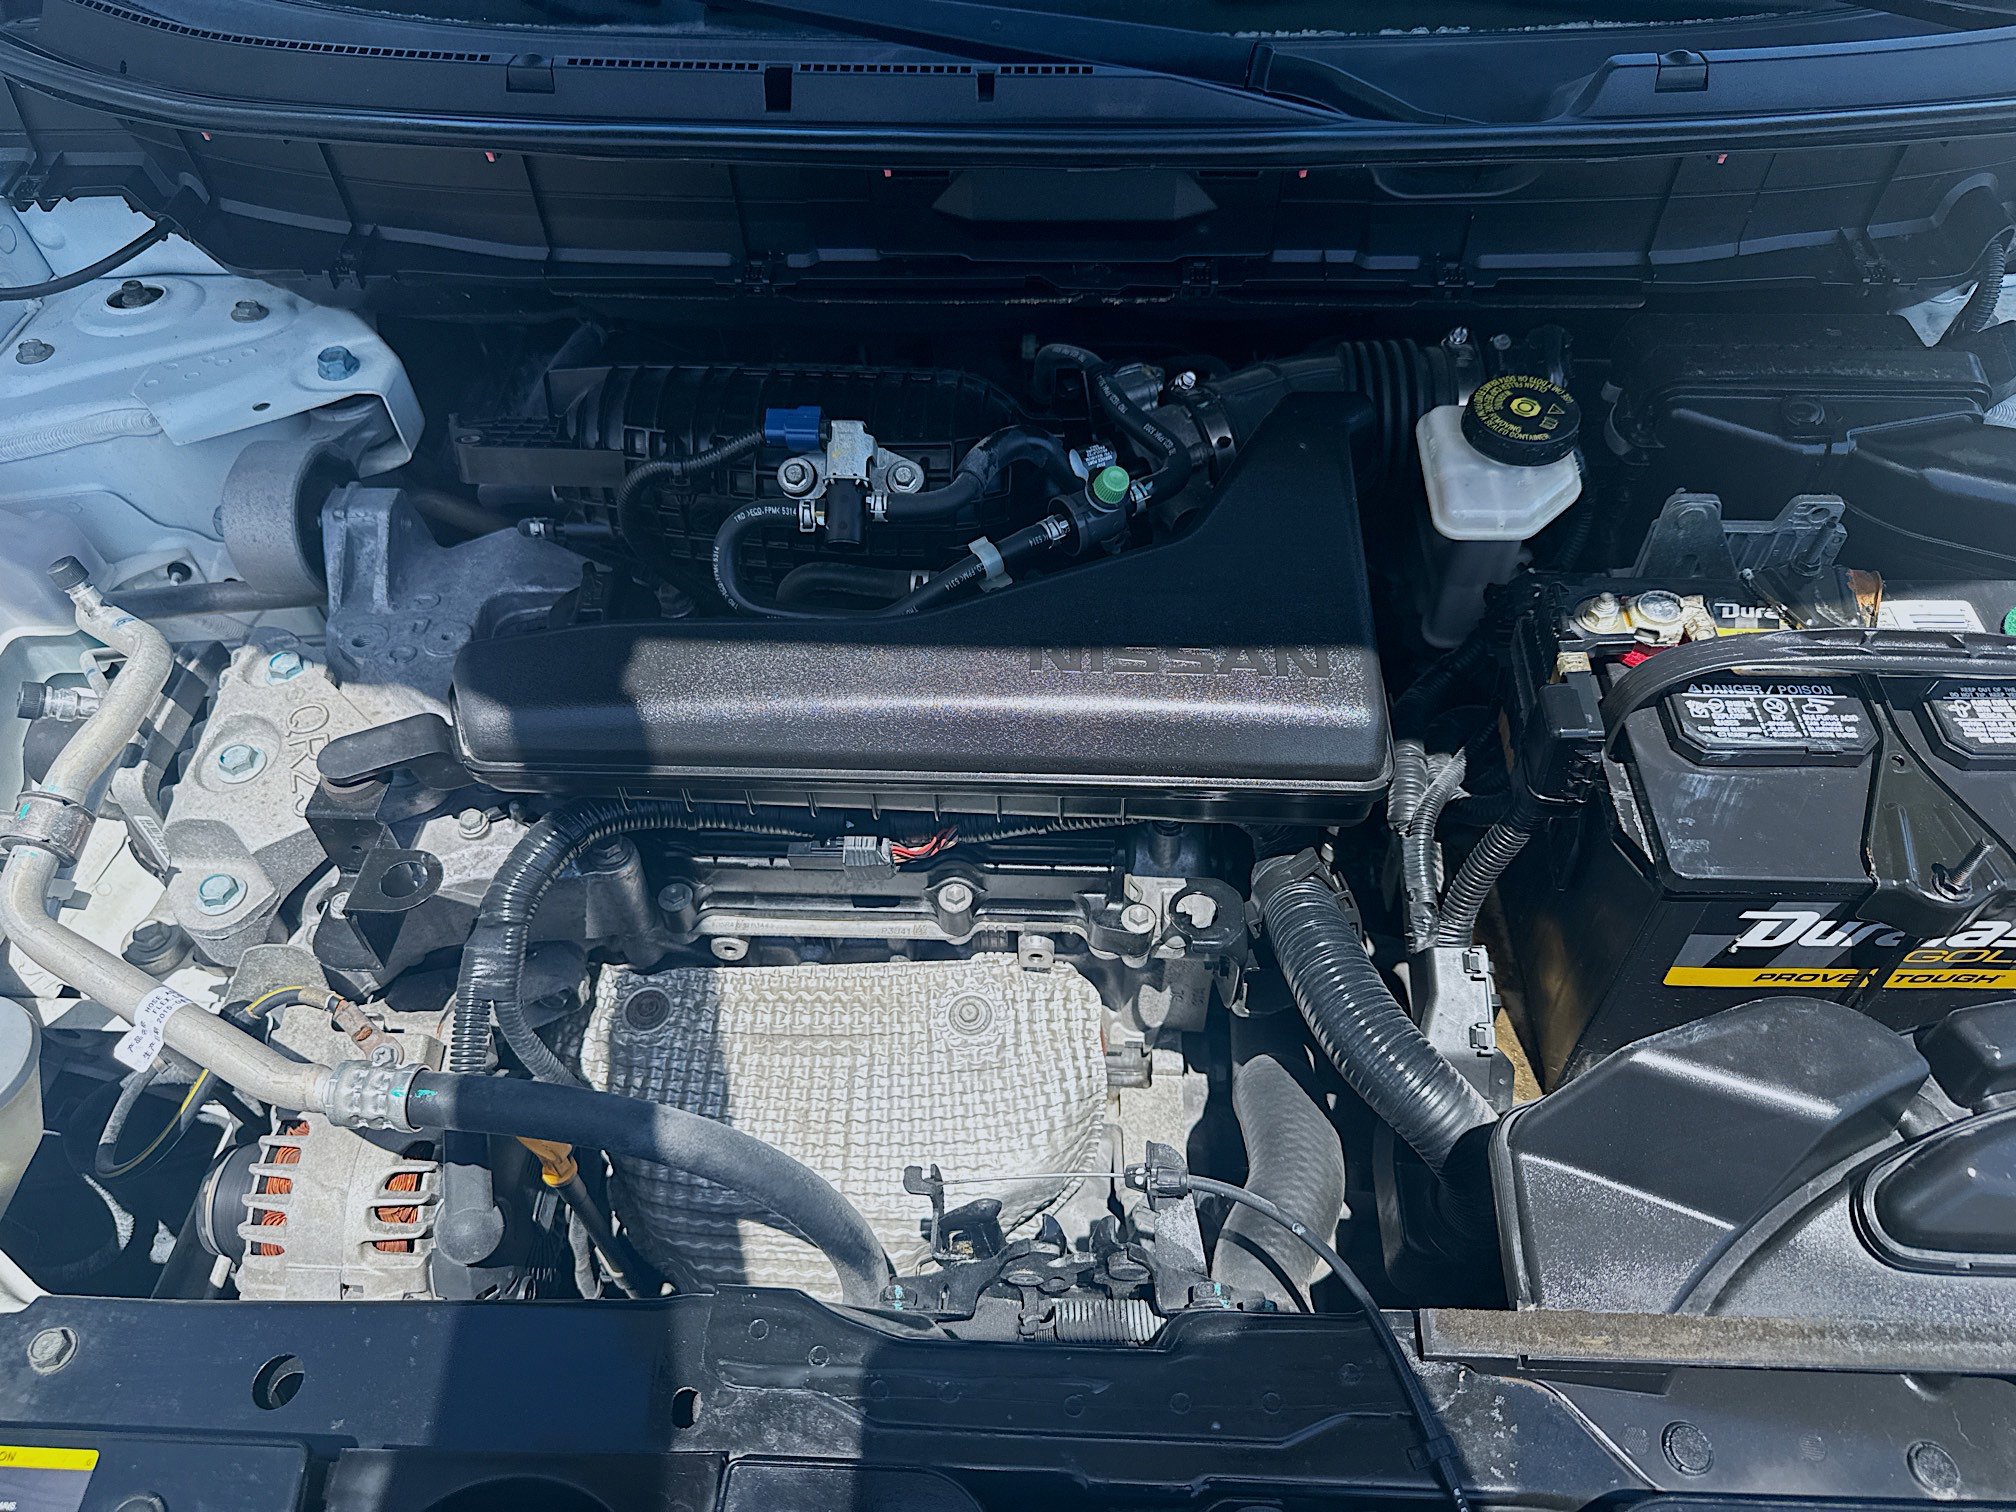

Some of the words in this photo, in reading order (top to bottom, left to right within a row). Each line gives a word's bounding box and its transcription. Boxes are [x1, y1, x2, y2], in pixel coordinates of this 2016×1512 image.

[1517, 375, 1529, 383] OR
[1525, 382, 1547, 393] CLEAN
[1485, 419, 1509, 435] SEALED
[781, 506, 797, 516] 5314
[944, 578, 961, 591] 5314
[1029, 647, 1332, 680] NISSAN
[1701, 684, 1762, 694] DANGER
[1777, 685, 1834, 695] POISON
[1802, 714, 1839, 722] SULFURIC
[1903, 948, 2016, 964] GOL
[1894, 974, 2001, 984] TOUGH
[144, 995, 162, 1013] HOSE
